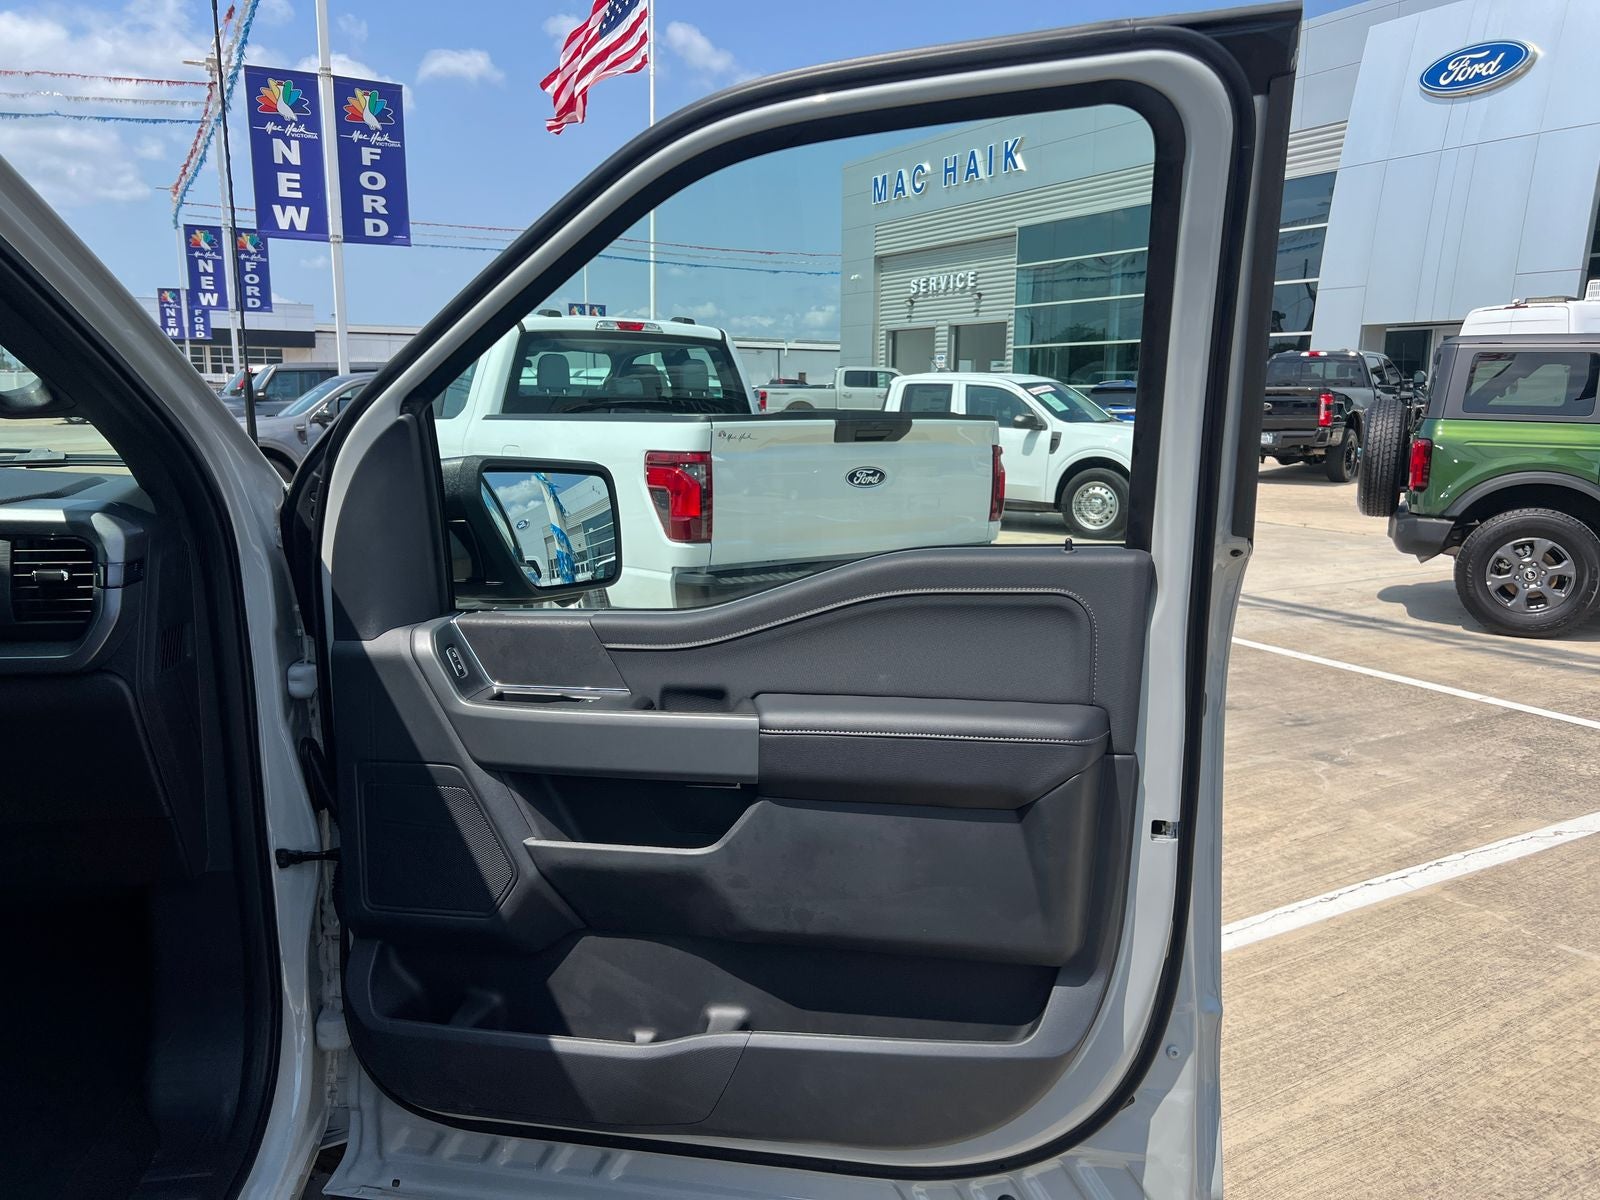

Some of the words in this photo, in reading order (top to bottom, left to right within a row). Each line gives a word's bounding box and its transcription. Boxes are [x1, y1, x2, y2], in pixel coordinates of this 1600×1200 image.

[1439, 50, 1506, 85] Ford
[253, 121, 284, 135] Mac
[285, 122, 318, 137] Haik
[340, 130, 369, 143] Mac
[370, 131, 400, 146] Haik
[271, 137, 310, 232] NEW
[872, 162, 930, 205] MAC
[943, 136, 1026, 188] HAIK
[359, 146, 389, 237] FORD
[197, 259, 219, 307] NEW
[243, 261, 262, 309] FORD
[909, 271, 978, 295] SERVICE
[165, 308, 179, 338] NEW
[193, 309, 206, 339] FORD
[853, 469, 881, 485] Ford
